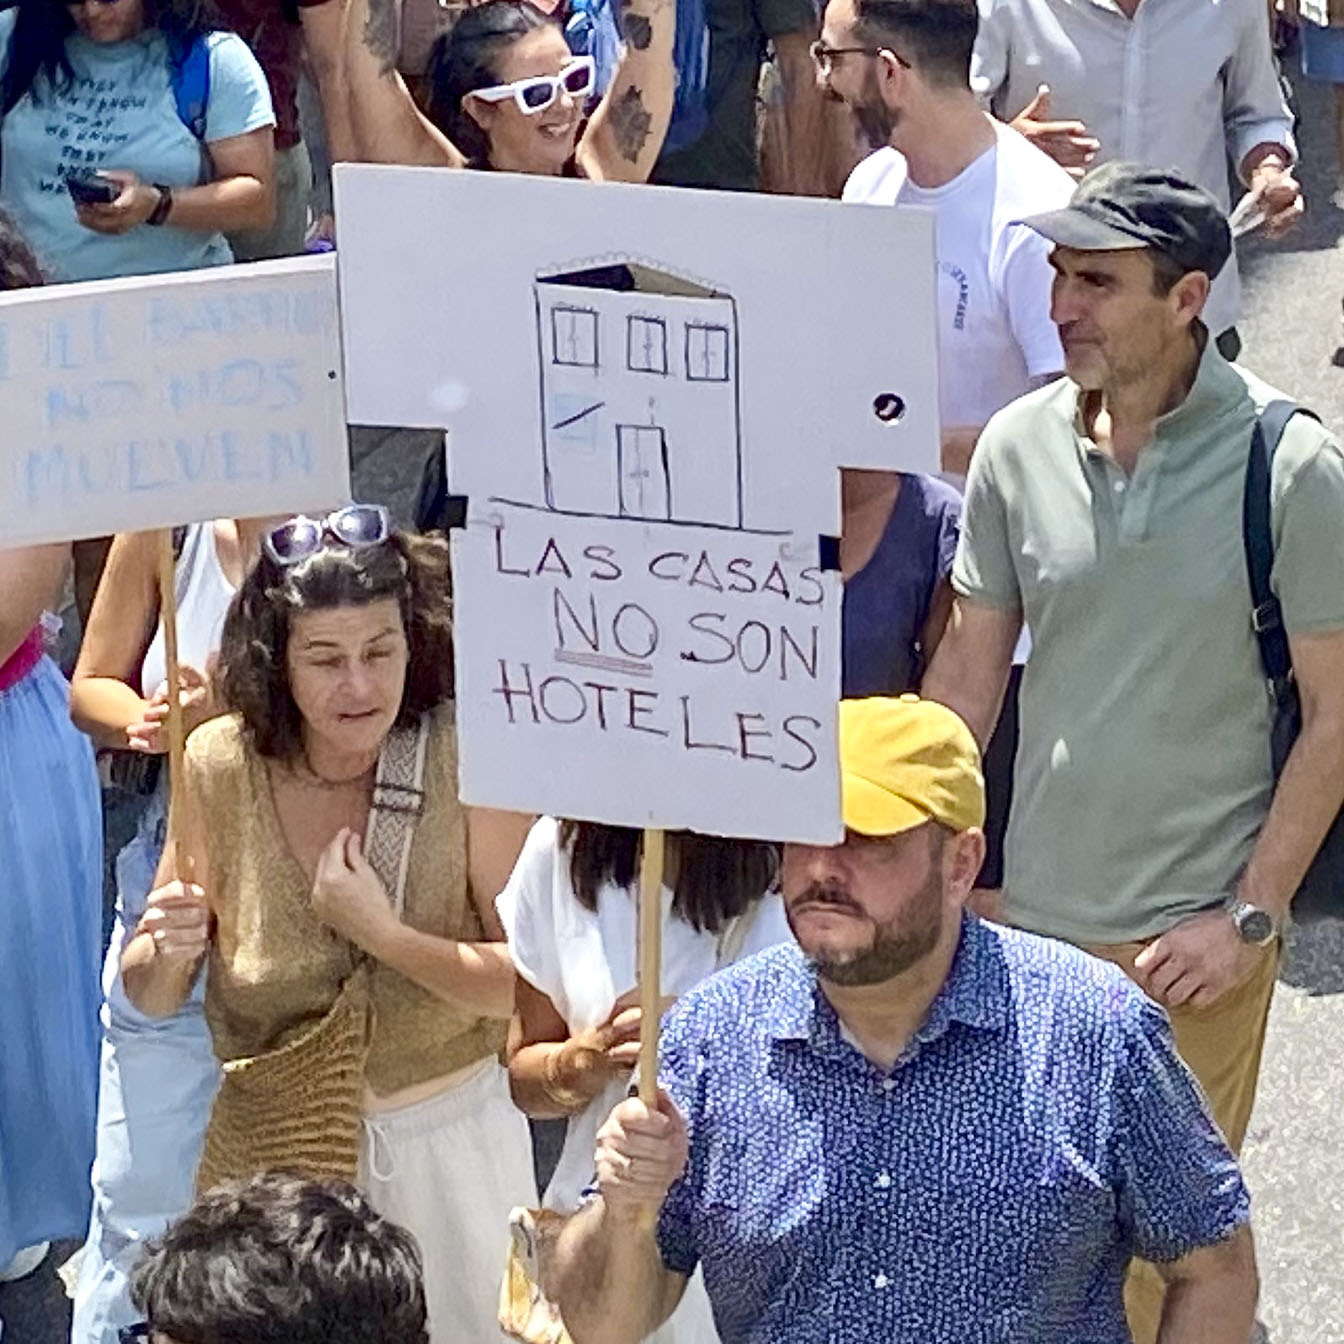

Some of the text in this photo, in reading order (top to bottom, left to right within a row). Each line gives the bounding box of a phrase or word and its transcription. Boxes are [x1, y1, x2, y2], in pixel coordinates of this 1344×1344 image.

[495, 527, 825, 606] LAS CASAS
[553, 586, 819, 680] NO SON
[492, 658, 822, 772] HOTELES
